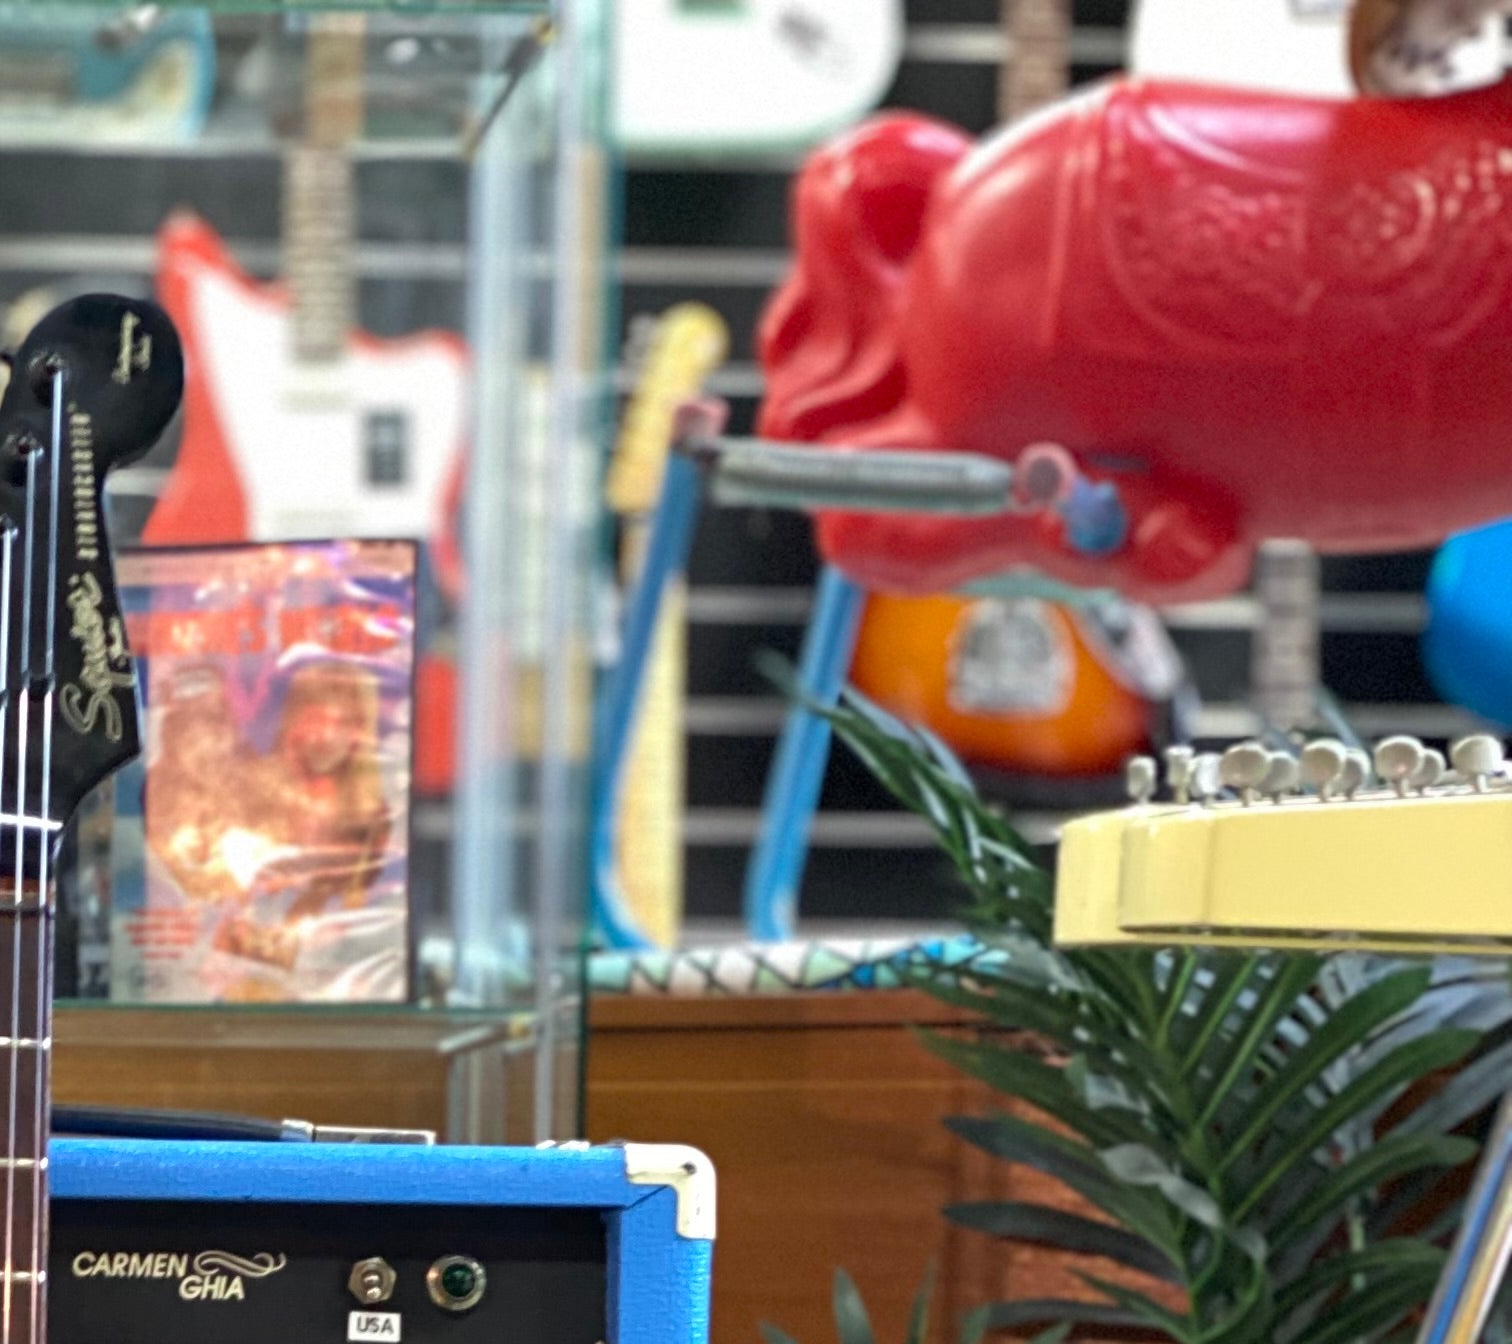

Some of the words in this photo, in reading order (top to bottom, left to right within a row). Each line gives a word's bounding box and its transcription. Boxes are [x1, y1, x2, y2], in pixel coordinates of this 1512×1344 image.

[72, 1251, 189, 1279] CARMEN
[178, 1275, 245, 1301] GHIA
[355, 1315, 395, 1335] USA
